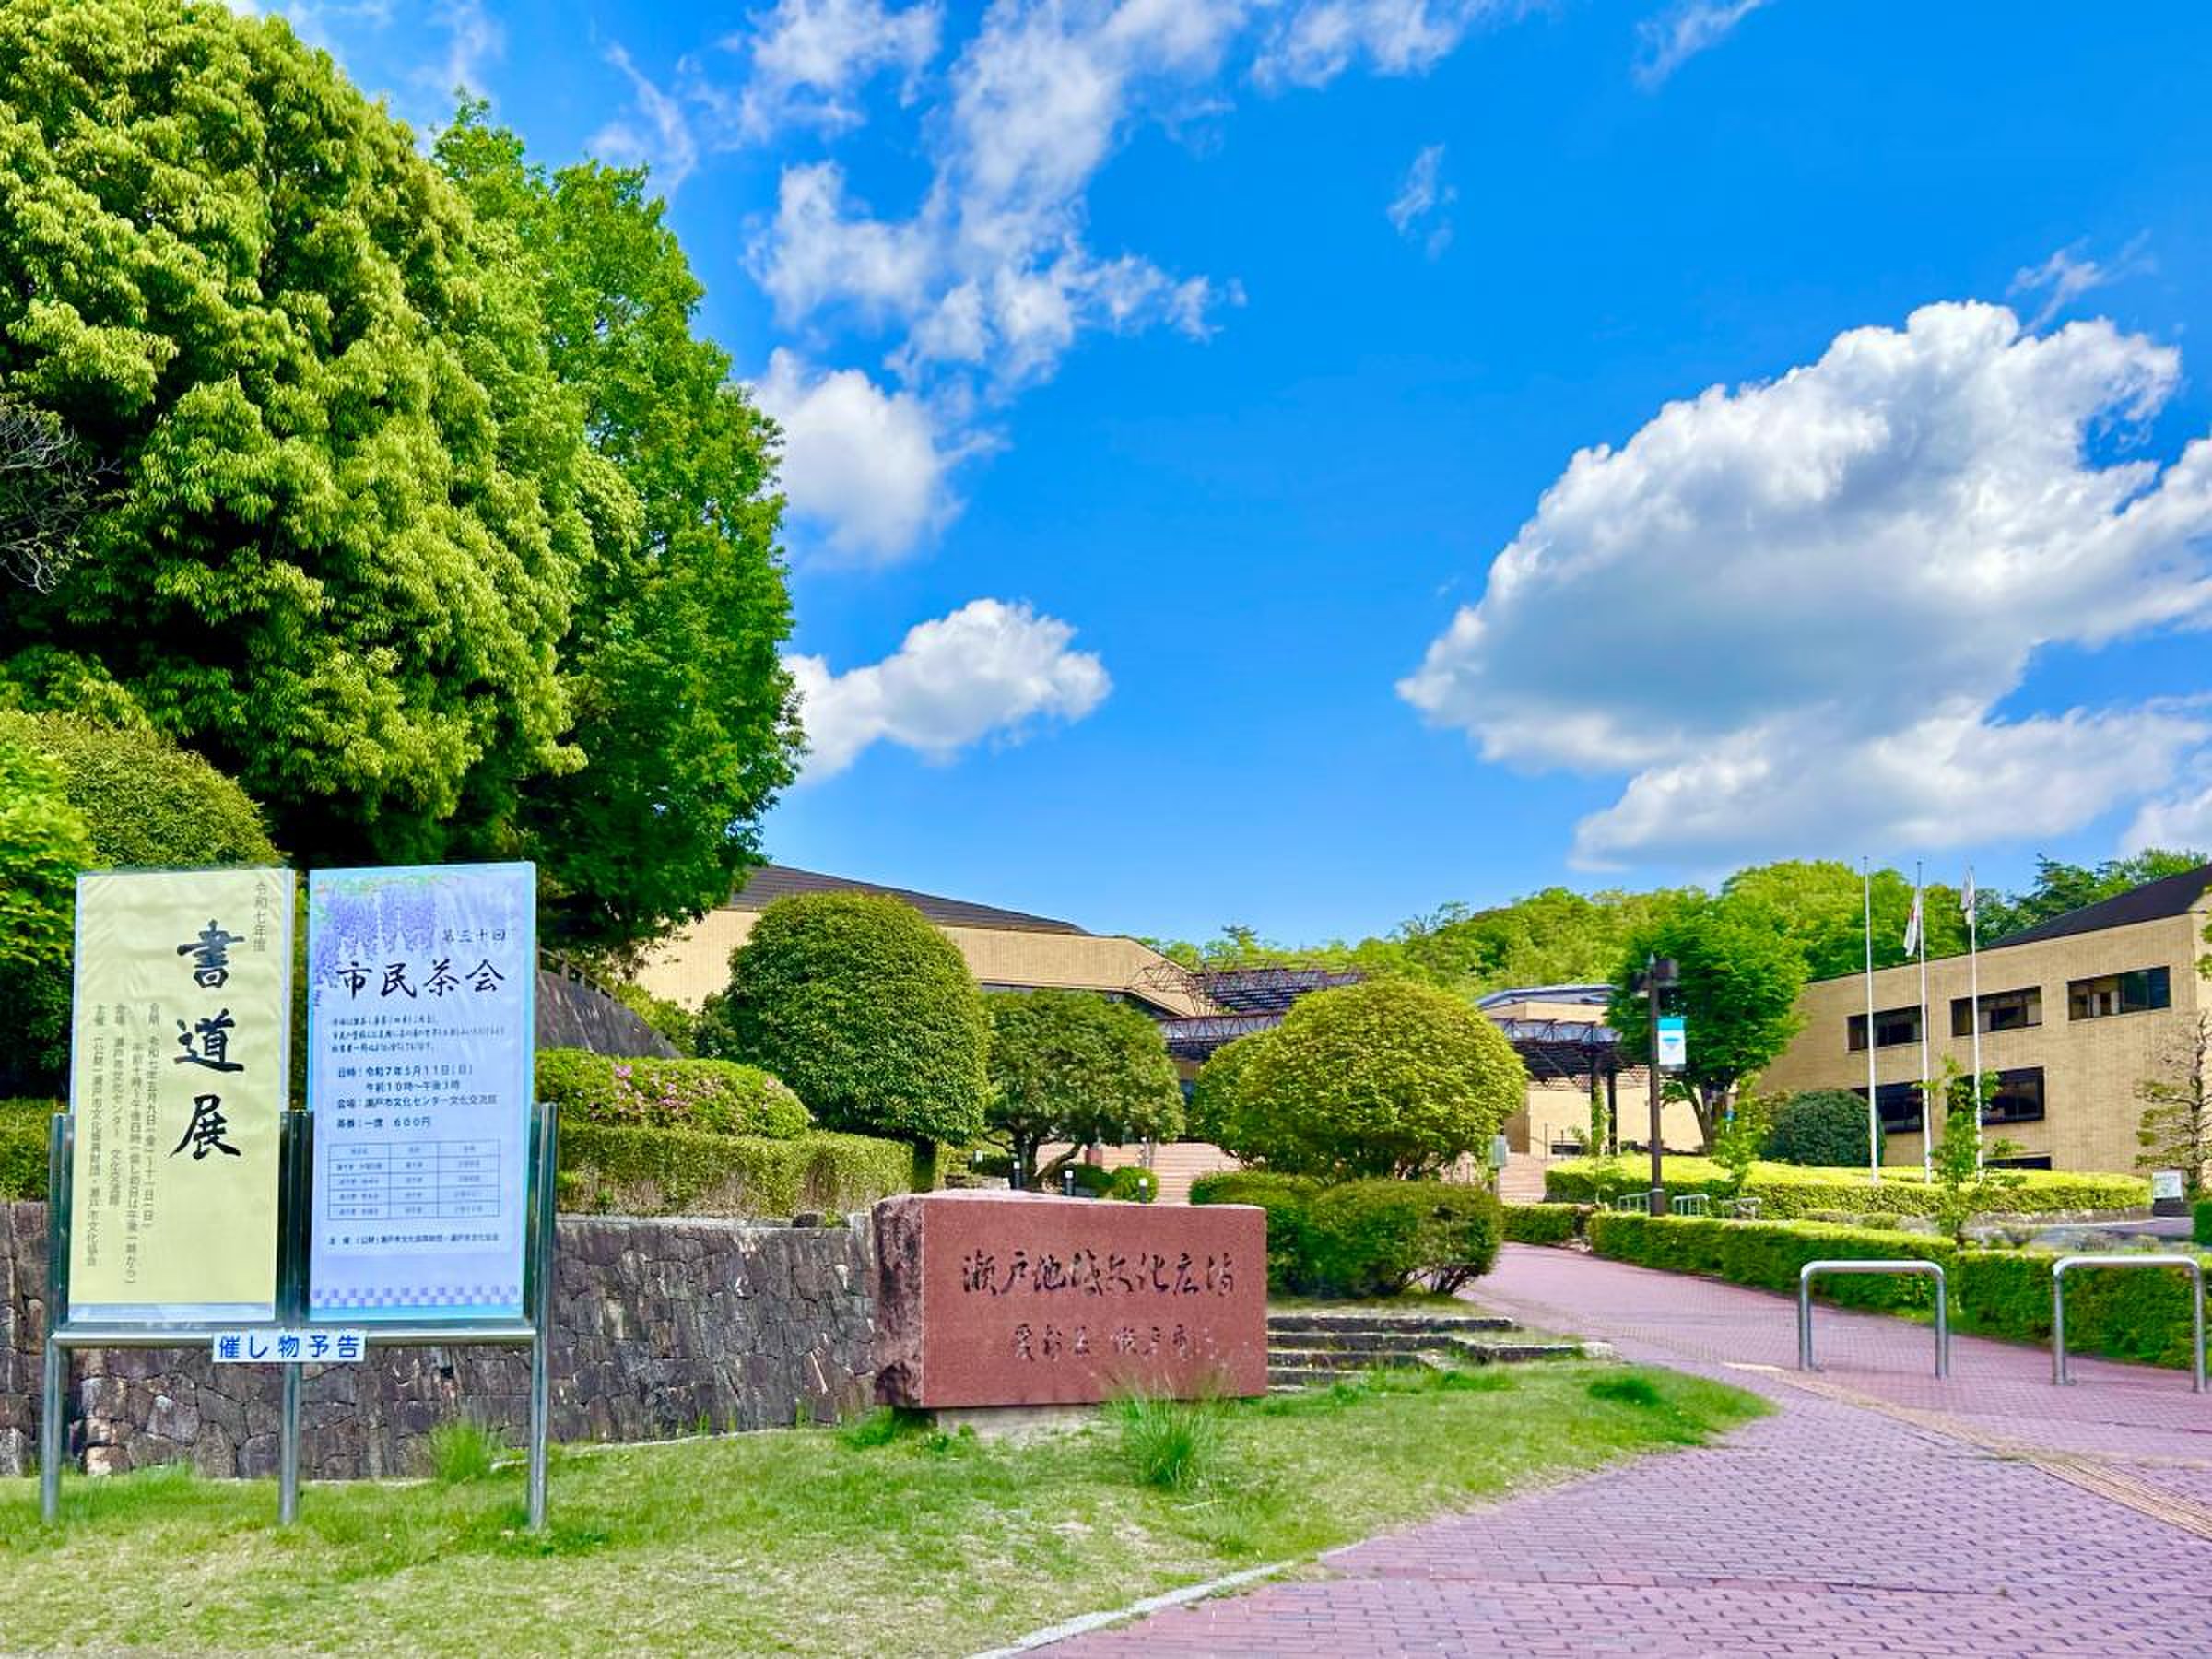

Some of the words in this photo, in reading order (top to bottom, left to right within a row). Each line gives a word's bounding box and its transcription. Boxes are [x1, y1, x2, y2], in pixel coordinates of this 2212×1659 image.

[442, 928, 506, 944] 第三十回
[336, 958, 505, 1000] 市民茶会
[167, 918, 245, 1160] 書道展
[219, 1335, 359, 1359] 催し物予告
